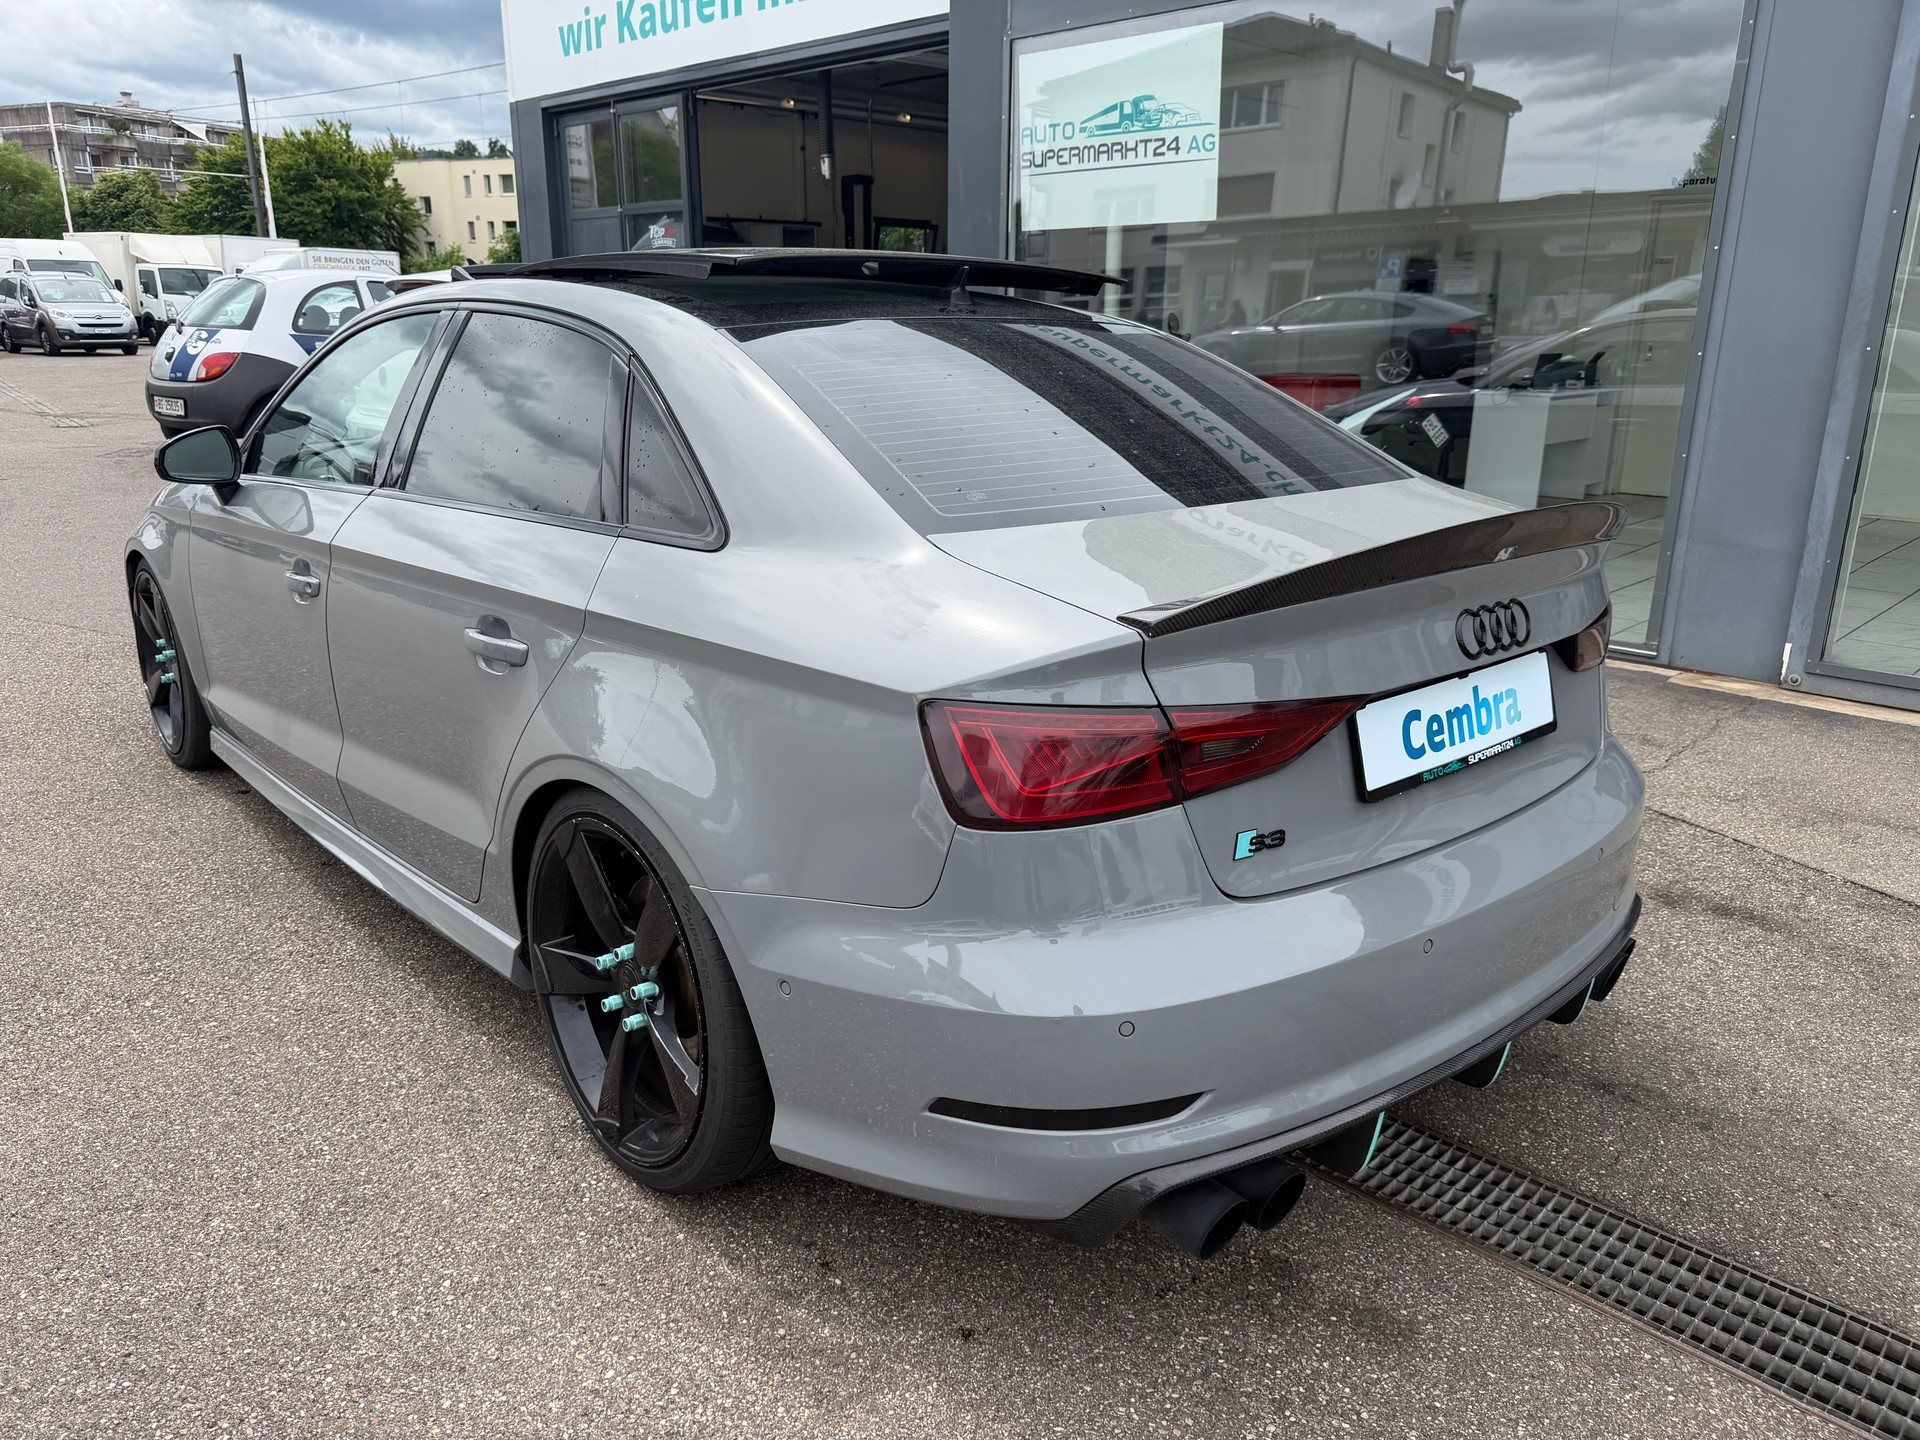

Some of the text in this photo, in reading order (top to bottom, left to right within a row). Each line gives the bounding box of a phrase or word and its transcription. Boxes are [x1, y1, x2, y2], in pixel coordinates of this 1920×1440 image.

[558, 6, 606, 57] wir
[1021, 121, 1075, 146] AUTO
[1021, 133, 1216, 169] SUPERMARKT24 AG
[324, 256, 354, 265] BRINGEN
[1402, 685, 1521, 760] Cembra
[1423, 767, 1444, 781] AUTO
[1467, 739, 1514, 764] SUPERMARKT24
[1248, 829, 1286, 853] S3
